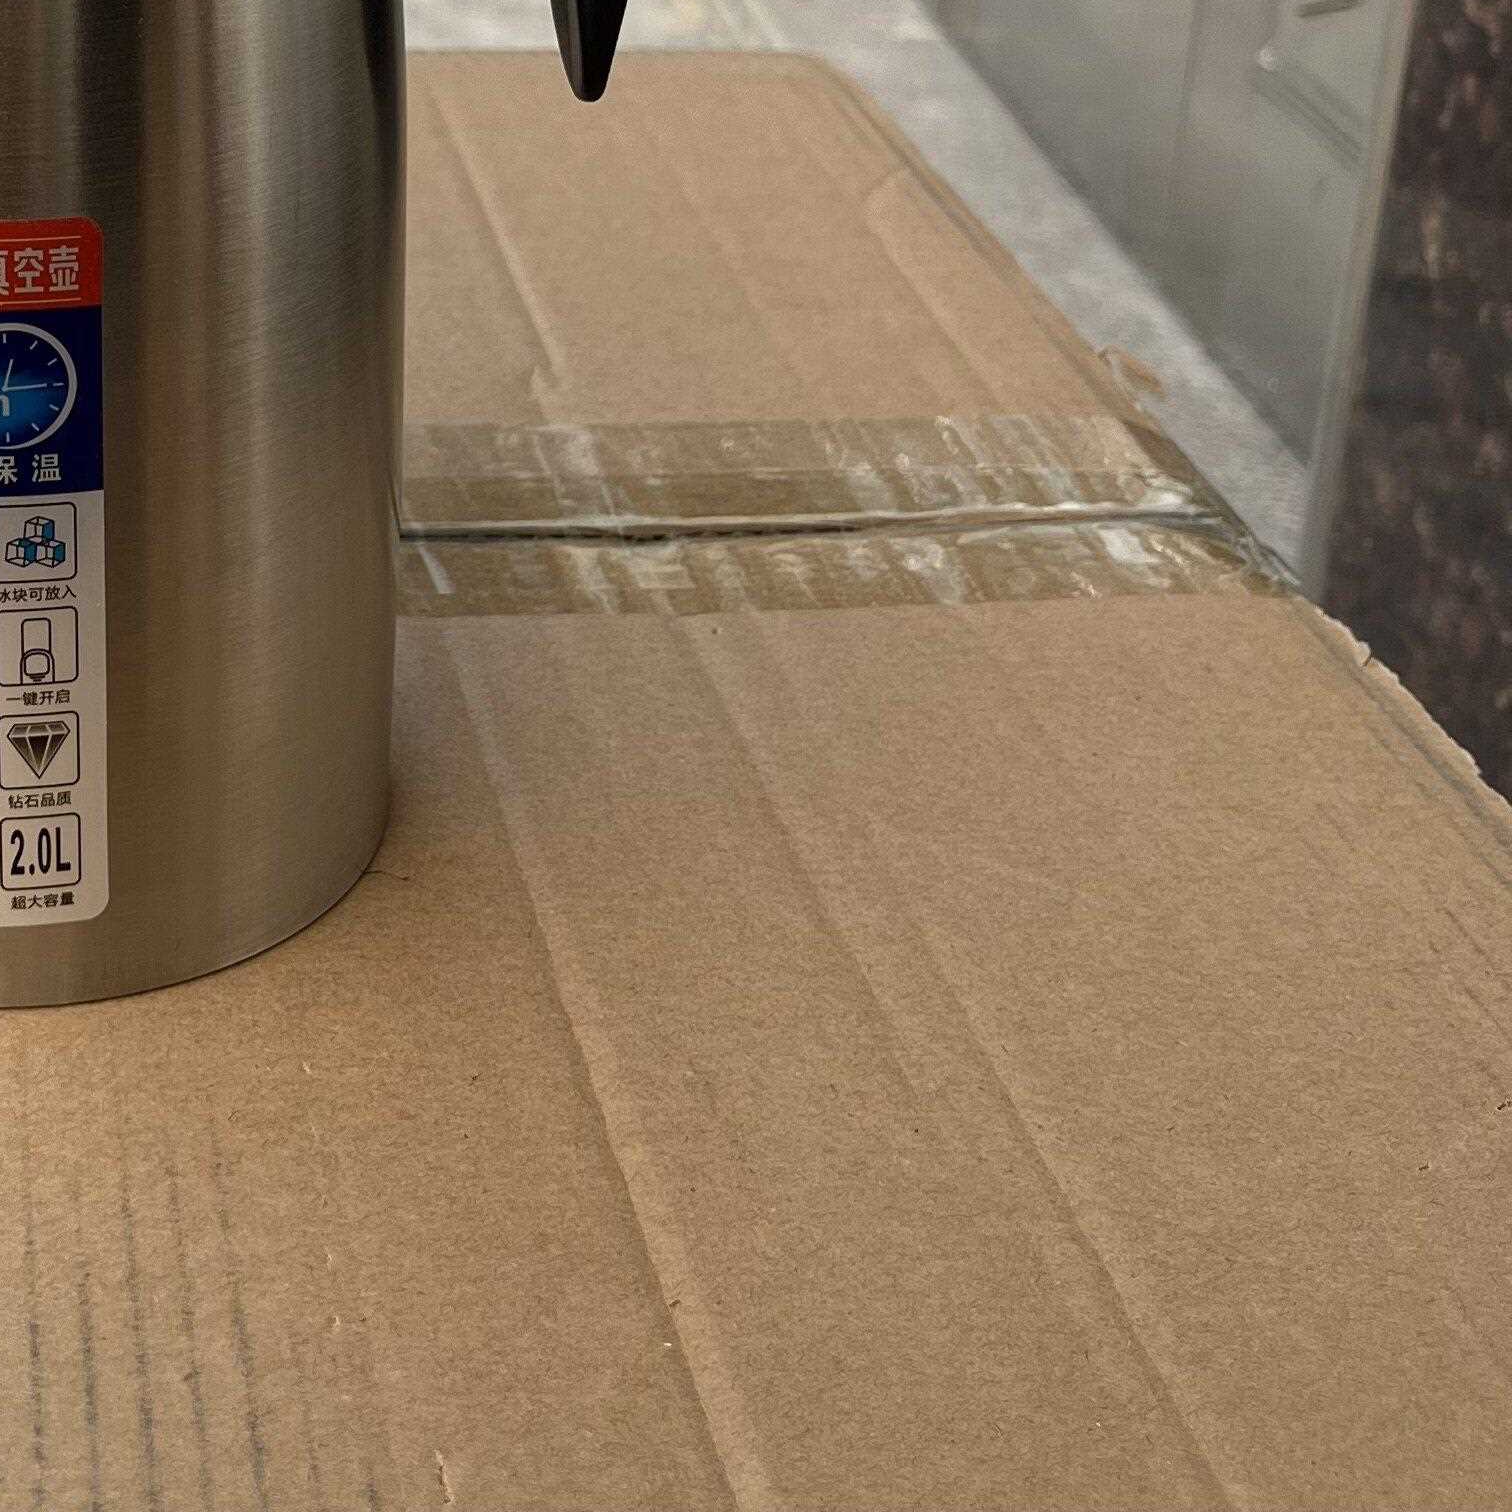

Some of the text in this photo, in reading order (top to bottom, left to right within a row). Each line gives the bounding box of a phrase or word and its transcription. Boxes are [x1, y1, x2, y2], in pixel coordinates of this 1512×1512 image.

[6, 690, 71, 707] 一键开启
[8, 791, 72, 809] 钻石品质
[9, 826, 71, 876] 2.0L
[10, 892, 75, 911] 超大容量
